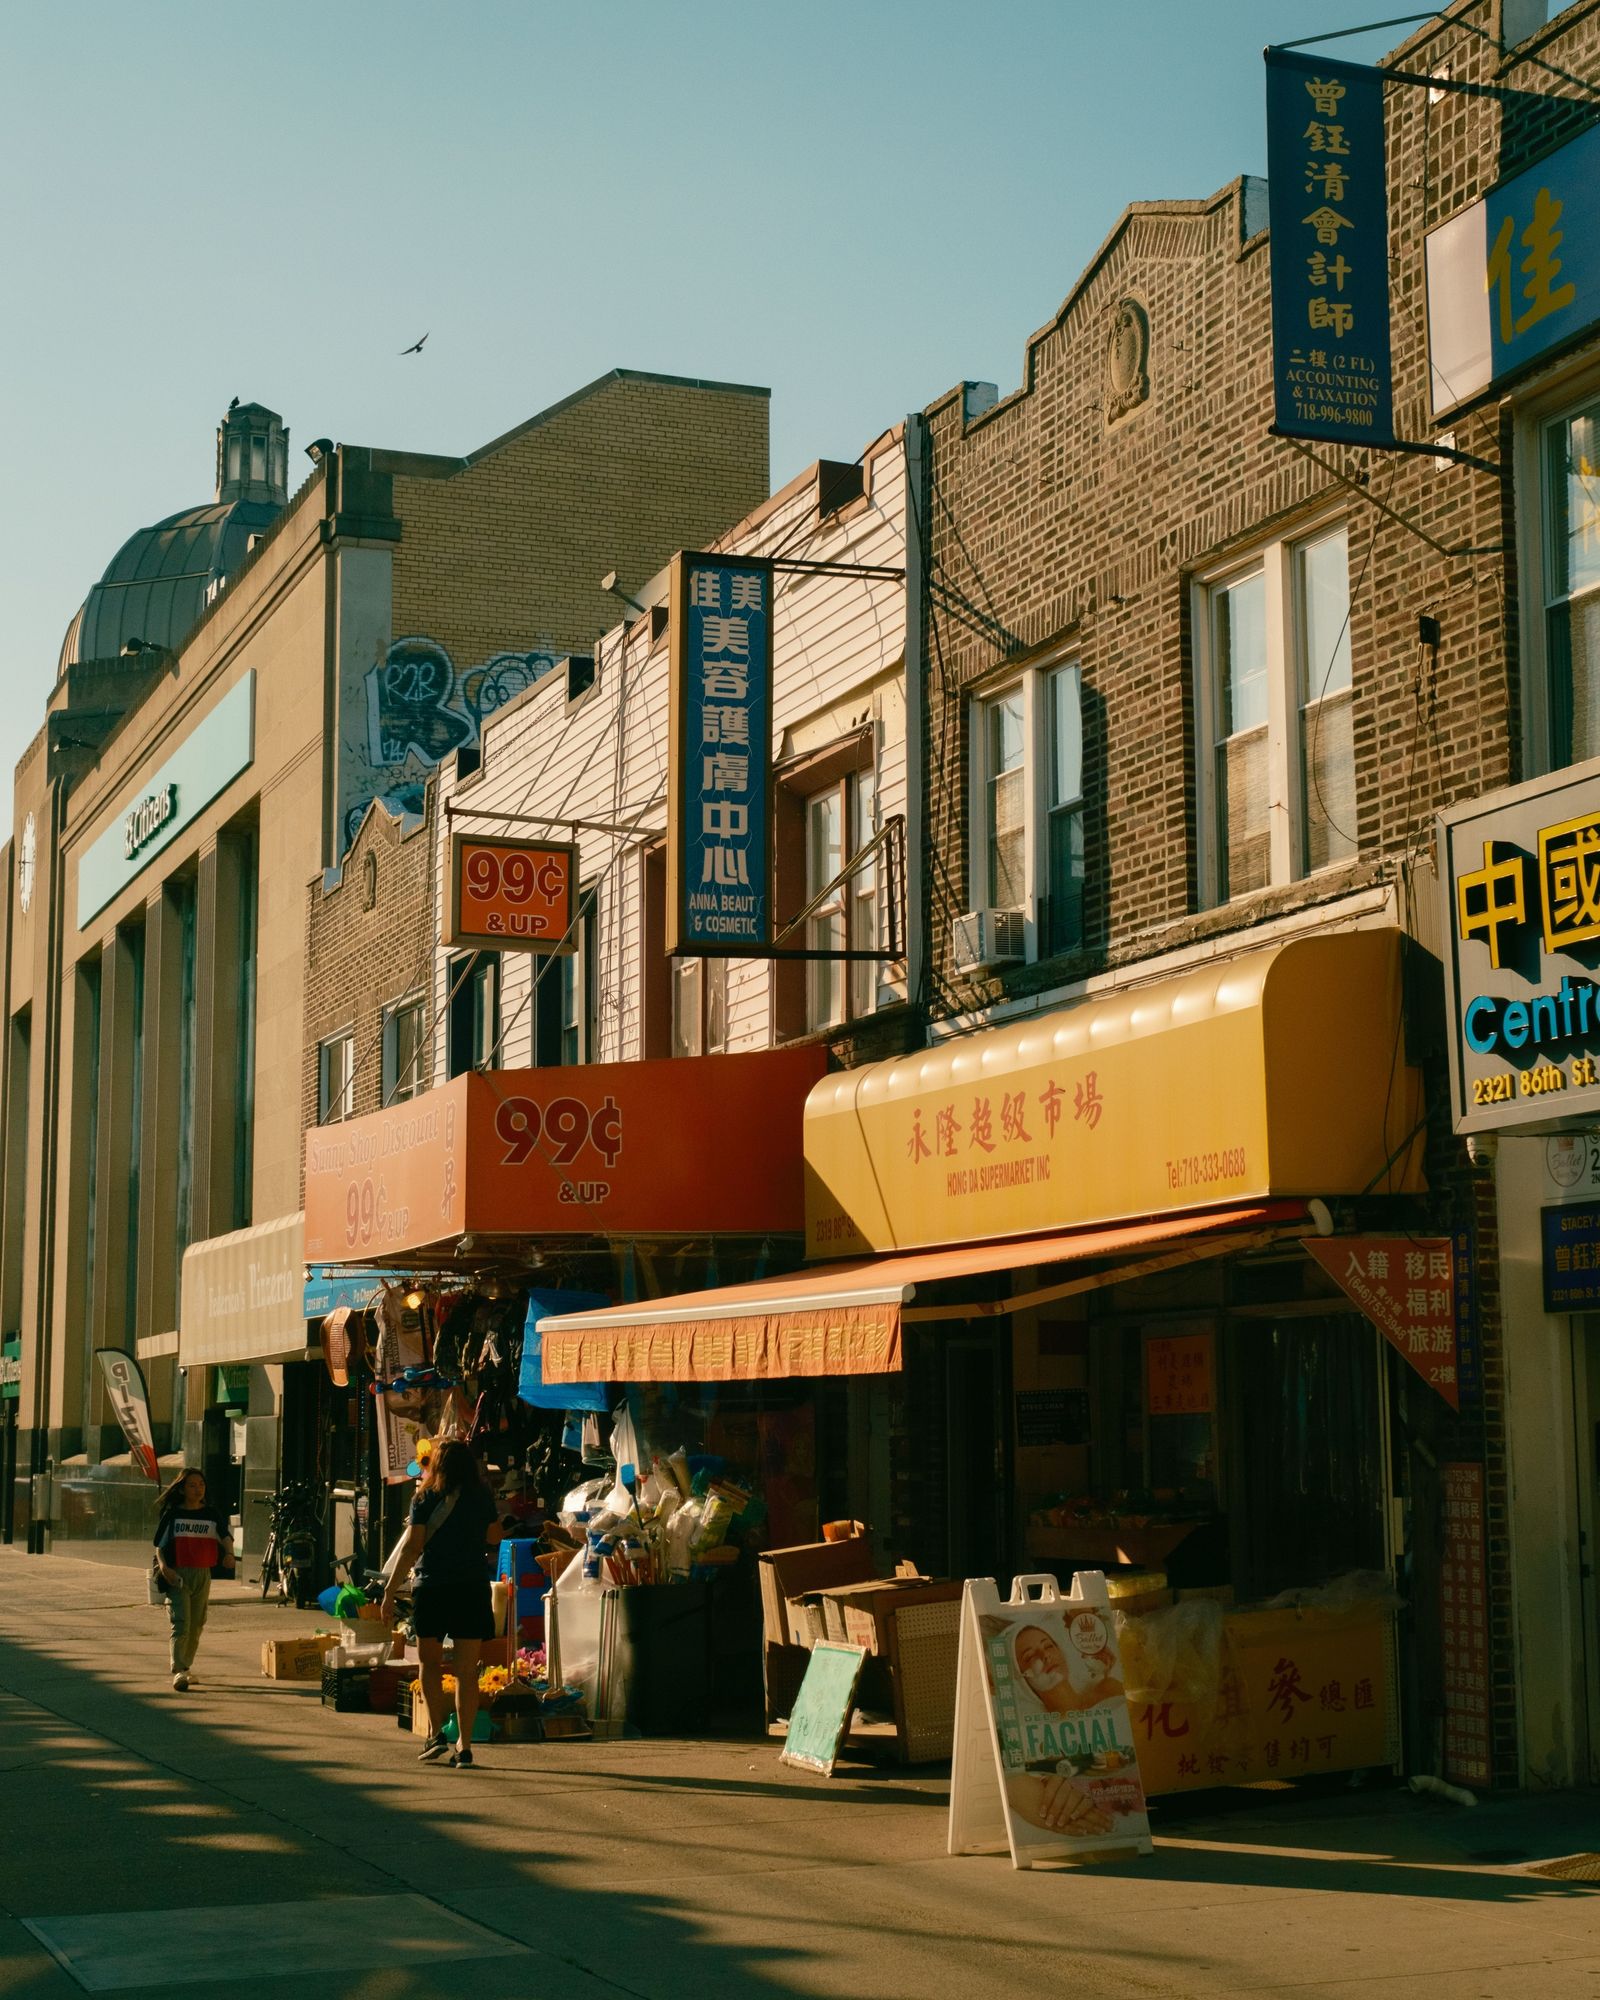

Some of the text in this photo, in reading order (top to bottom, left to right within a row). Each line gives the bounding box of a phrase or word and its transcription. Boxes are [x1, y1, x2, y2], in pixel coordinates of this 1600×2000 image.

[1302, 77, 1354, 338] 曾鈺清會計師
[1484, 187, 1576, 345] 佳
[1286, 369, 1379, 391] ACCOUNTING
[1332, 355, 1346, 369] (2
[1350, 356, 1375, 374] FL)
[1292, 385, 1378, 407] & TAXATION
[1296, 402, 1373, 427] 718-996-9800
[690, 571, 763, 613] 佳美
[702, 615, 750, 886] 美容護膚中心
[133, 783, 176, 850] Citizens
[466, 850, 565, 907] 99¢
[689, 893, 755, 913] ANNA BEAUT
[486, 912, 549, 935] & UP
[694, 914, 757, 935] & COSMETIC
[1465, 975, 1600, 1054] Centr
[1472, 1057, 1597, 1105] 2321 86th St.
[494, 1094, 623, 1169] 99¢
[907, 1070, 1104, 1165] 永隆超級市場
[311, 1099, 441, 1180] Sunny Shop Discount
[947, 1153, 1051, 1197] HONG DA SUPERMARKET INC
[346, 1174, 388, 1249] 99¢
[1561, 1215, 1594, 1232] STACEY
[816, 1219, 832, 1243] 2319
[1345, 1250, 1450, 1281] 入籍 移民
[1348, 1275, 1407, 1341] (646)753-3948
[1406, 1288, 1451, 1317] 福利
[1407, 1325, 1454, 1354] 旅游
[1430, 1365, 1456, 1384] 2樓
[176, 1523, 210, 1535] BONJOUR
[1025, 1708, 1113, 1722] DEEP CLEAN
[1025, 1718, 1122, 1757] FACIAL
